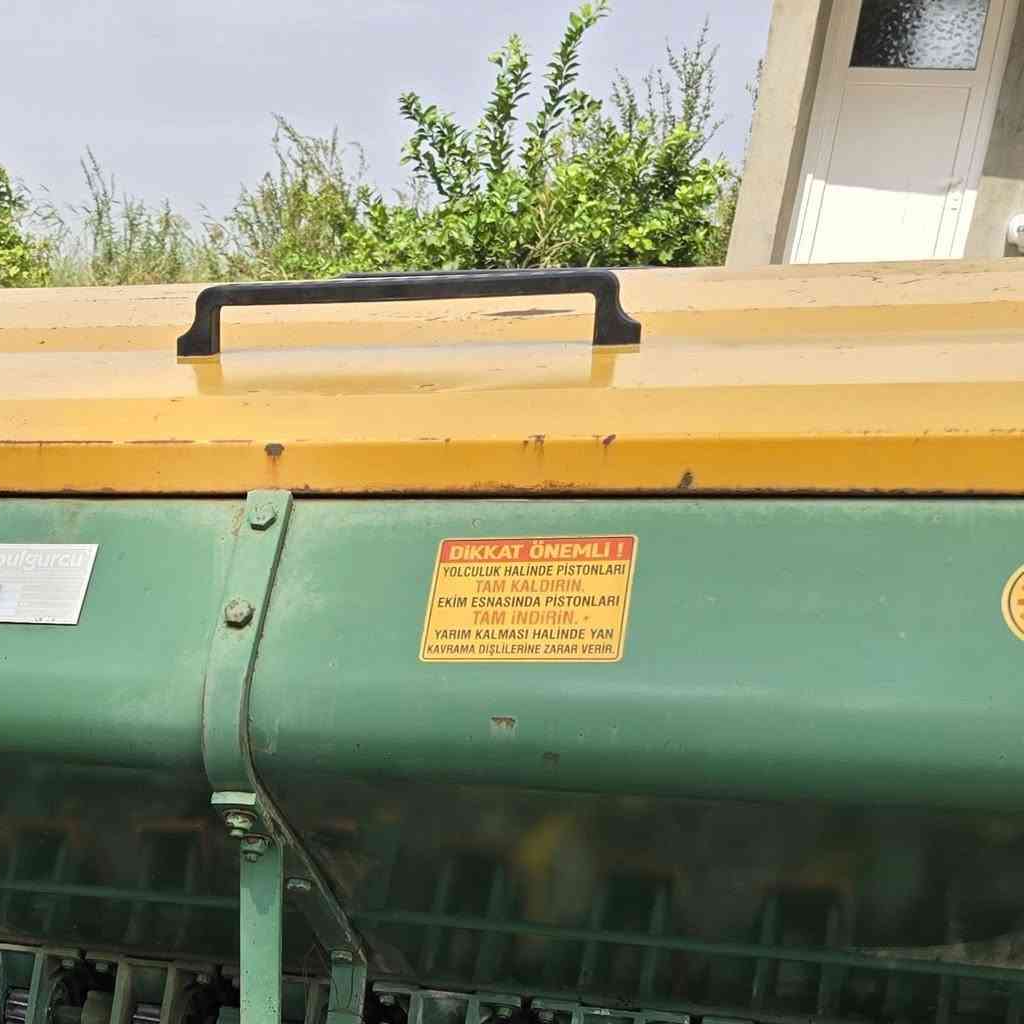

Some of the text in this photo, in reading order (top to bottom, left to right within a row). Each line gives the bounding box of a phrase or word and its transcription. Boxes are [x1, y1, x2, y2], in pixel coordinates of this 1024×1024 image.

[449, 544, 524, 560] DİKKAT
[443, 562, 625, 577] YOLCULUK HALİNDE PİSTONLARI
[475, 579, 585, 593] TAM KALDIRIN.
[438, 594, 468, 608] EKİM
[471, 596, 541, 607] ESNASINDA
[472, 611, 506, 624] TAM
[435, 627, 614, 639] YARIM KALMASI HALİNDE YAN
[427, 644, 475, 654] KAVRAMA
[544, 644, 578, 654] ZARAR
